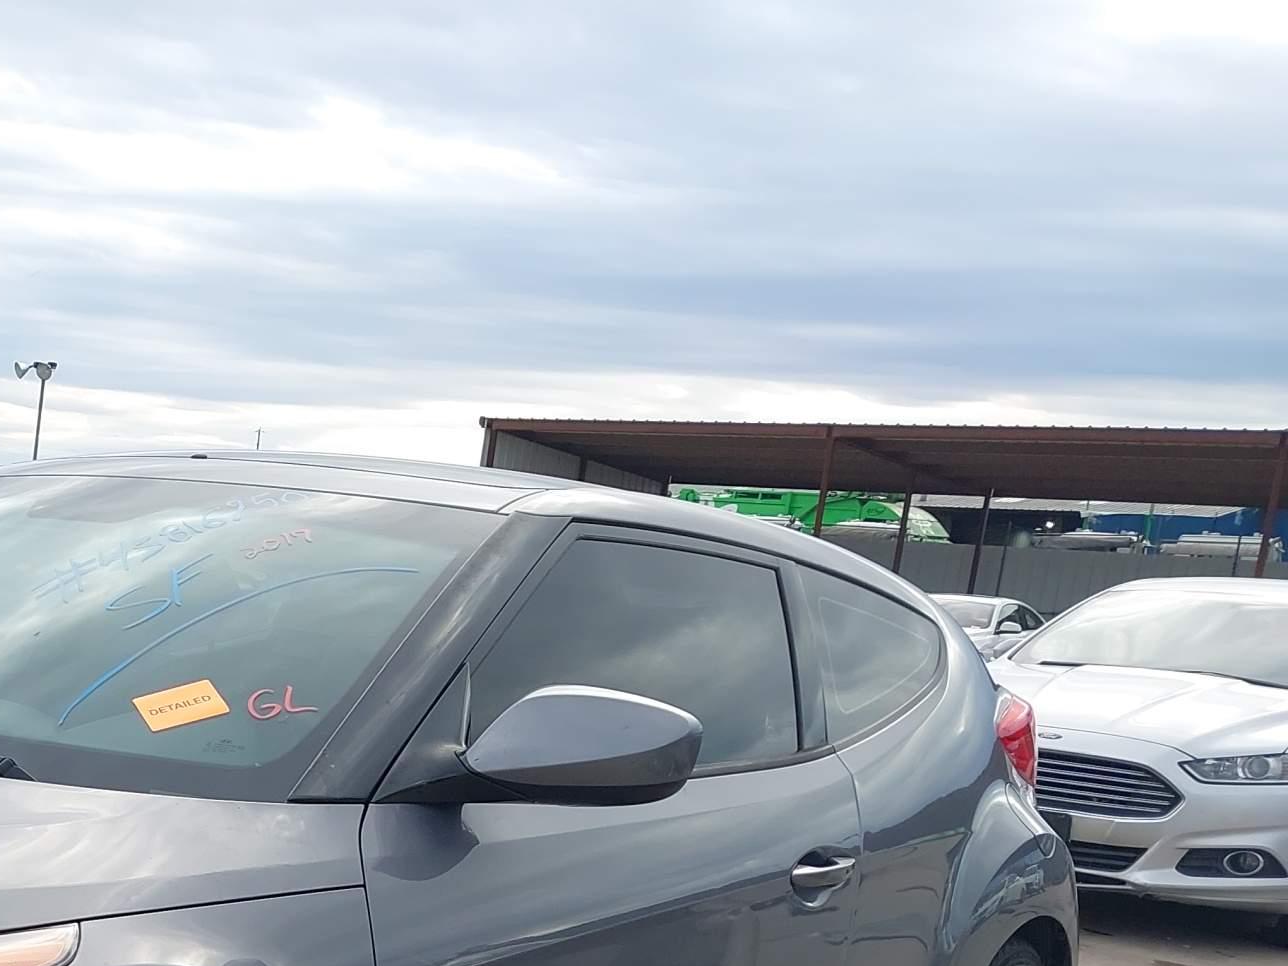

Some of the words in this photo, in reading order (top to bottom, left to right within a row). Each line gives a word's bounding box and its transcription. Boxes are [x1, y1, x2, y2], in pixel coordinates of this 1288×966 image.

[104, 552, 214, 631] SF
[148, 694, 212, 717] DETAILED
[247, 685, 320, 721] GL
